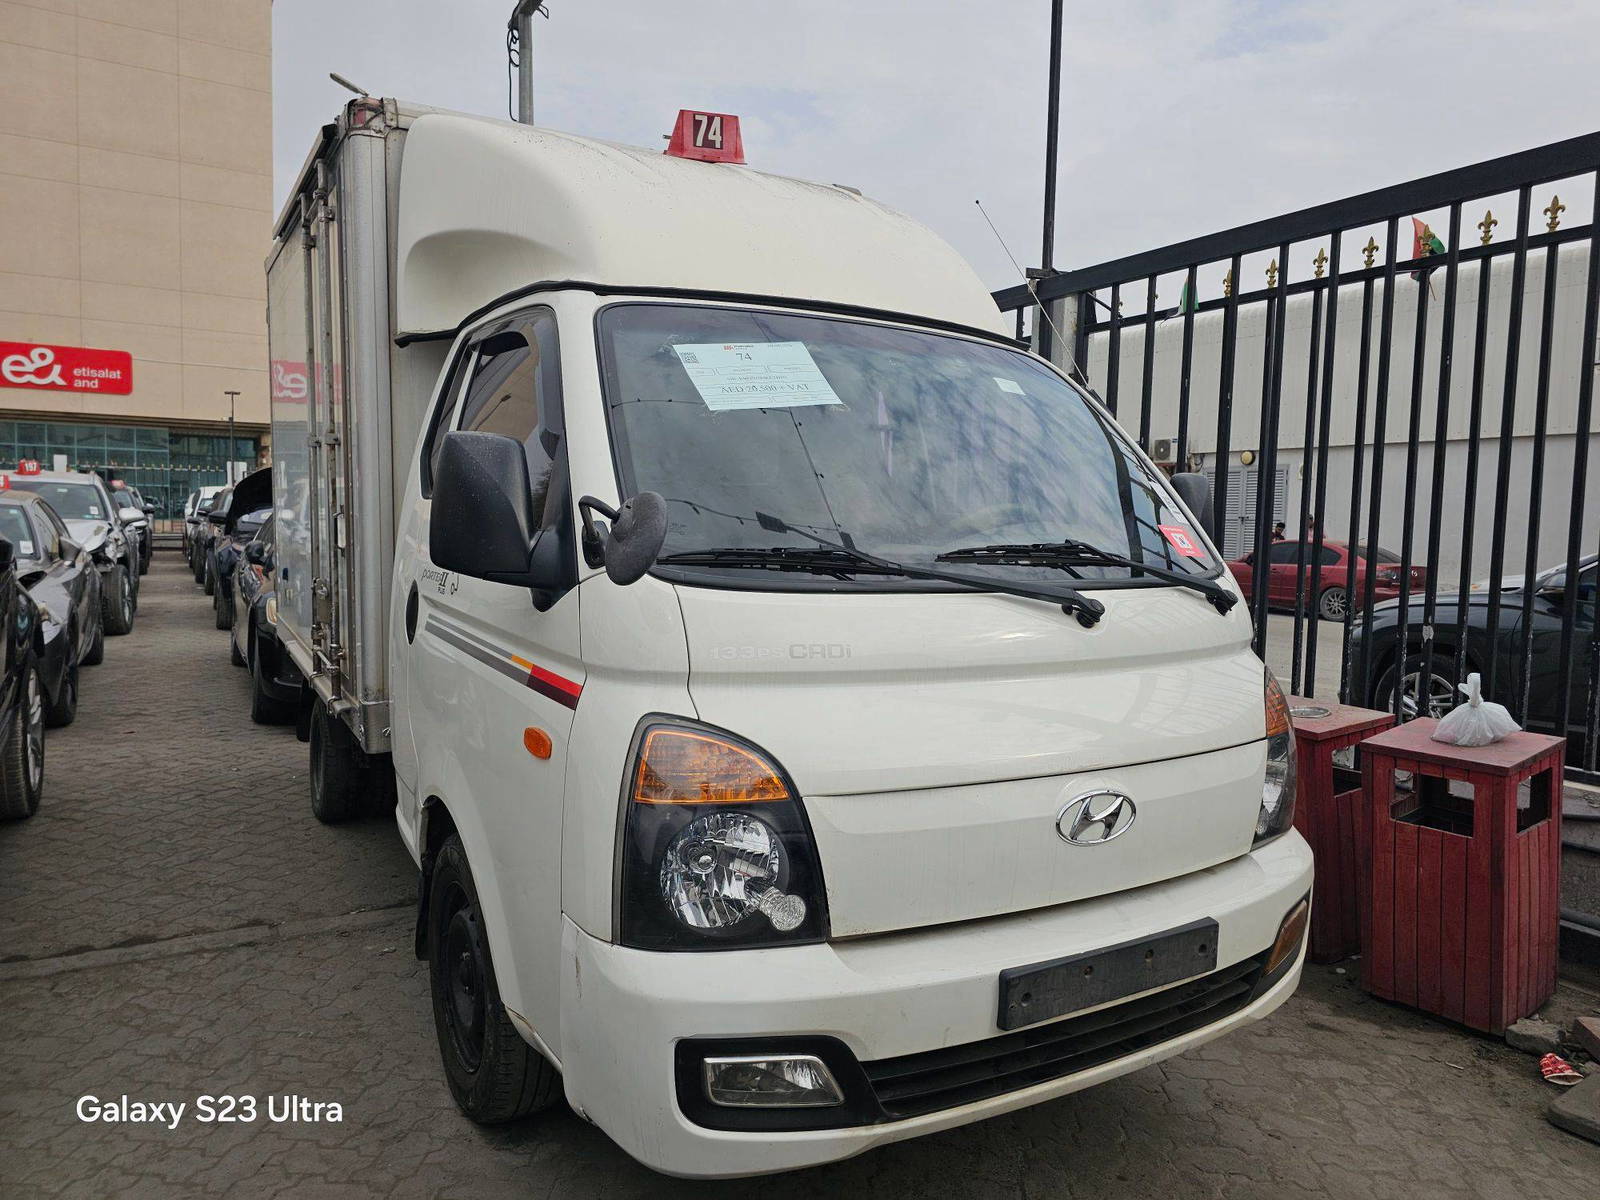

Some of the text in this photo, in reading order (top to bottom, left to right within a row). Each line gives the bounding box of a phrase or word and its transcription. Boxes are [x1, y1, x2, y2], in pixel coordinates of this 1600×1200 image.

[694, 114, 722, 149] 74
[735, 352, 753, 362] 74
[73, 366, 122, 380] etisalat
[73, 377, 99, 389] and
[721, 384, 745, 394] AED
[786, 383, 810, 392] VAT
